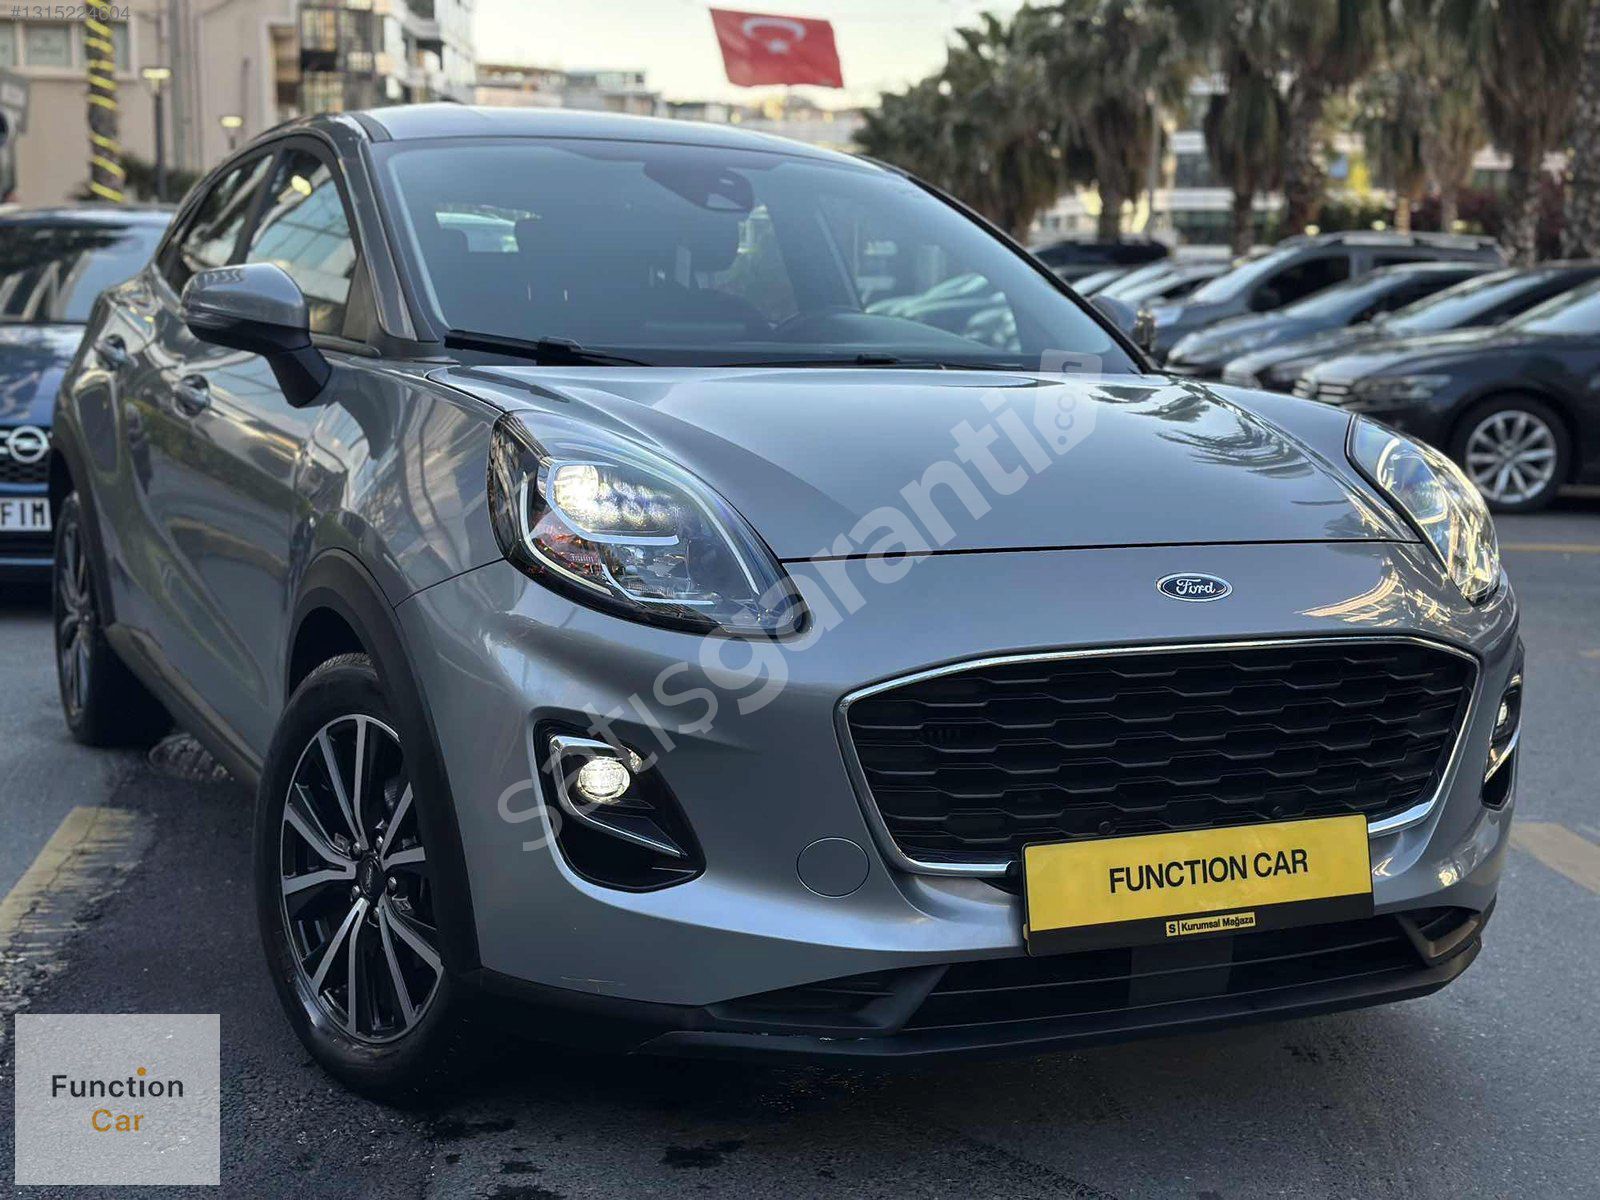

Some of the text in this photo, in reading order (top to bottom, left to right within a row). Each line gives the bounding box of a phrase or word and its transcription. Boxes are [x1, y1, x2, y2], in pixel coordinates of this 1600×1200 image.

[1176, 579, 1216, 594] Ford
[1109, 849, 1308, 893] FUNCTION CAR
[1181, 918, 1220, 932] Kurumsal
[1222, 915, 1254, 927] Mağaza
